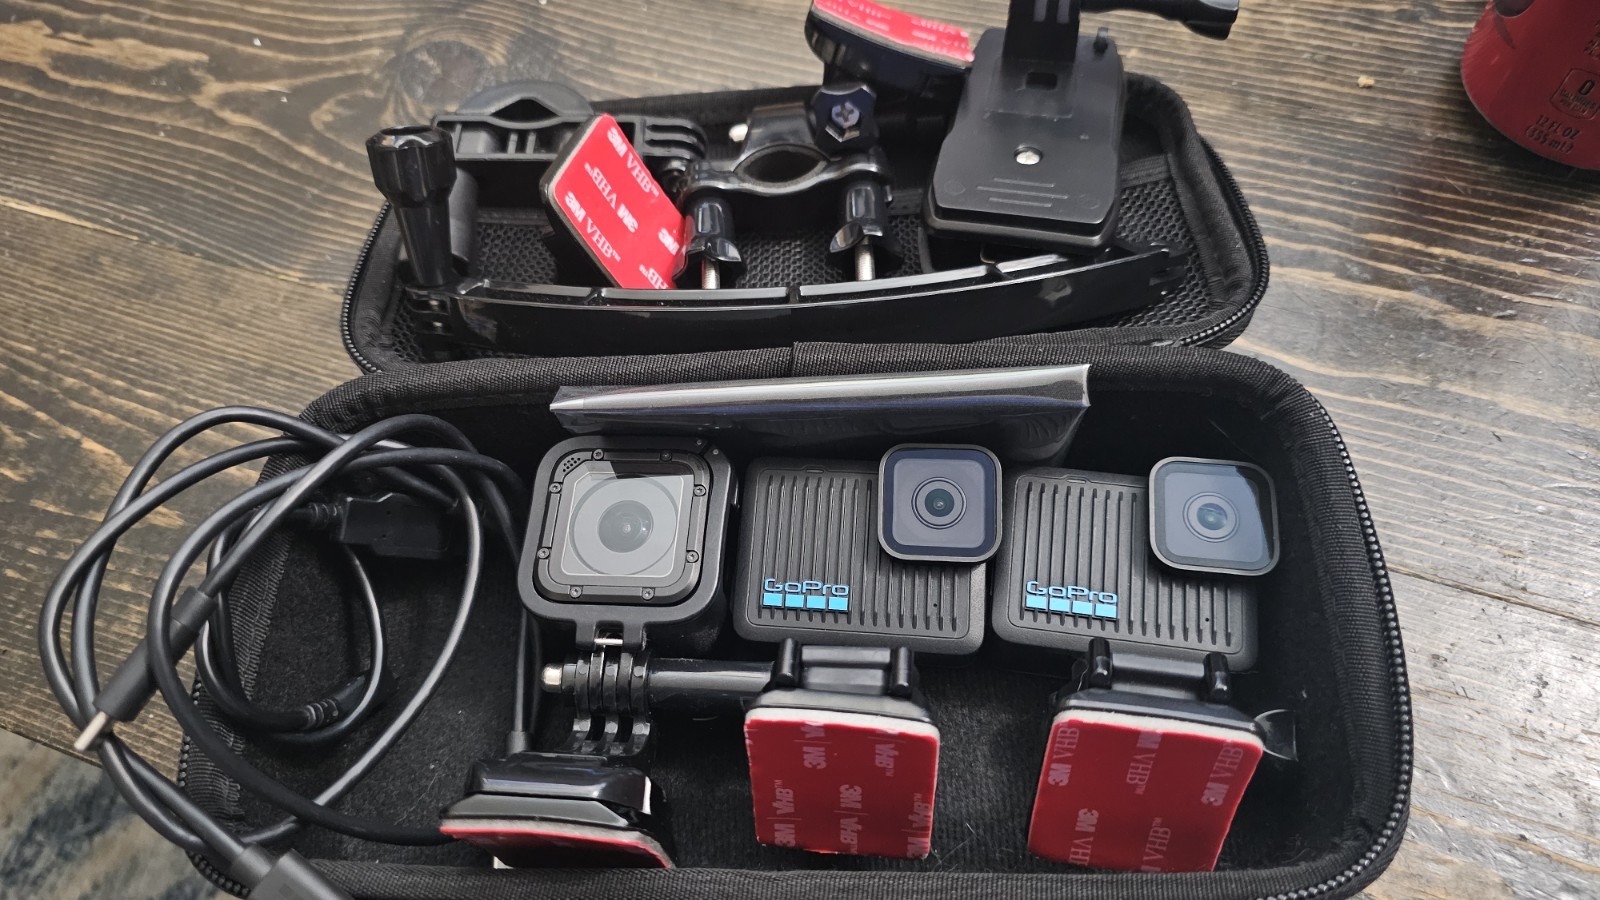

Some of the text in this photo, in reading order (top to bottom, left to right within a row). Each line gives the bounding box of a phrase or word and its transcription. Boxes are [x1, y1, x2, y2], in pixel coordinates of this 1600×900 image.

[1548, 121, 1562, 134] FL
[607, 127, 628, 158] 3M
[565, 191, 587, 222] 3M
[617, 203, 639, 233] 3M
[658, 228, 679, 256] 3M
[764, 578, 849, 596] GoPro
[1026, 581, 1118, 603] GoPro
[803, 746, 827, 769] 3M
[1048, 763, 1072, 787] 3M
[840, 784, 862, 809] 3M
[1201, 781, 1229, 806] 3M
[1075, 808, 1099, 833] 3M
